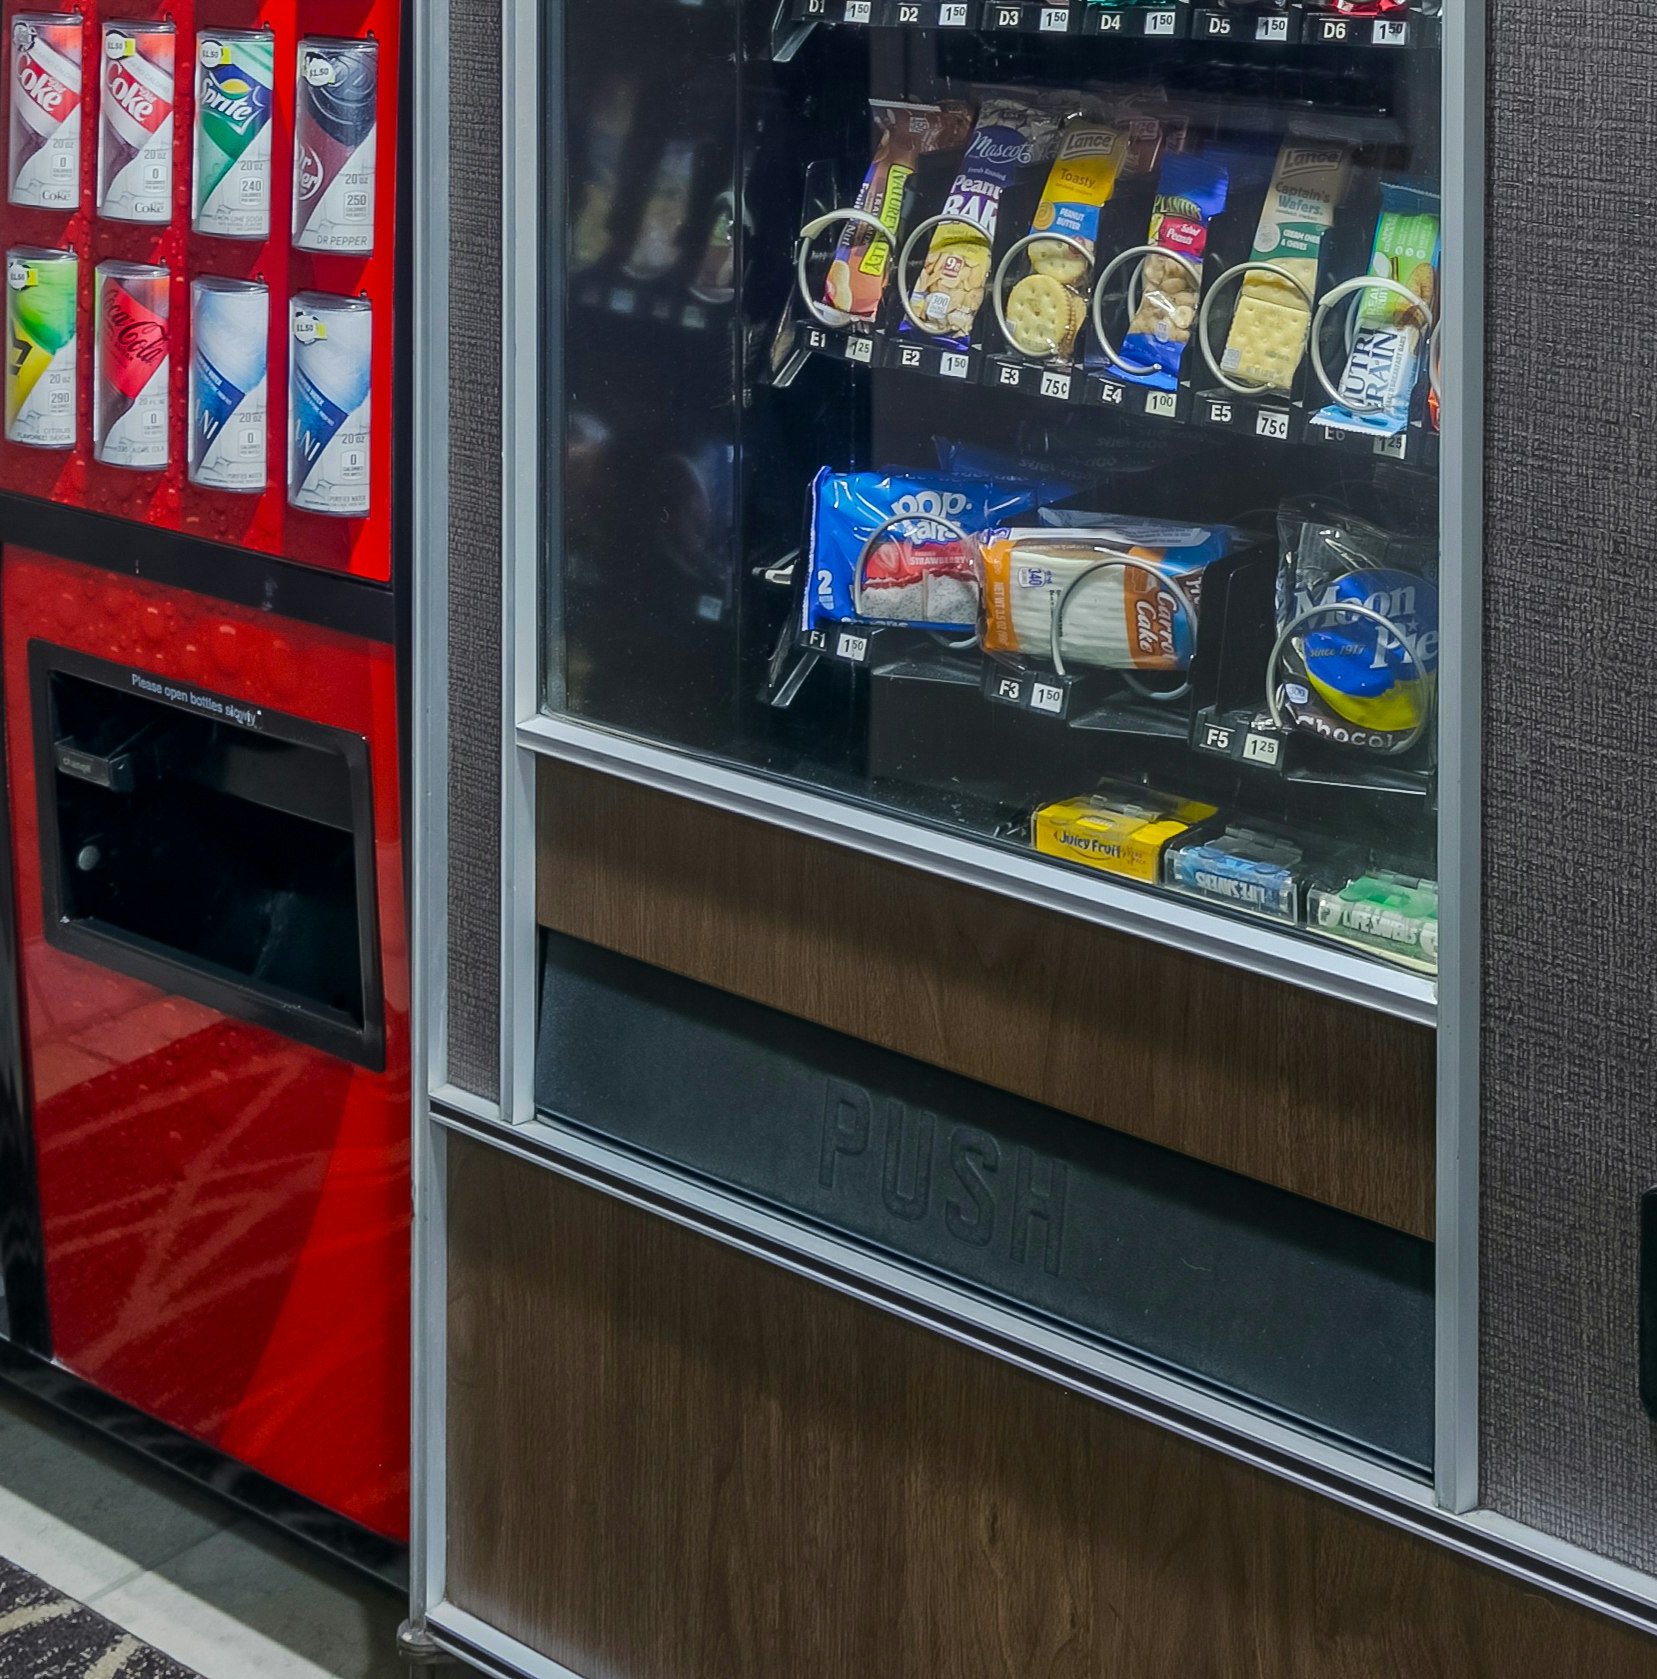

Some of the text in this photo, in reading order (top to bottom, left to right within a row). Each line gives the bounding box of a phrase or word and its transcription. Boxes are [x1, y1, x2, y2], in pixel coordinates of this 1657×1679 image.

[900, 7, 919, 22] D2
[999, 10, 1019, 26] D3
[1101, 14, 1120, 30] D4
[1209, 18, 1231, 34] D5
[1323, 22, 1346, 39] D6
[309, 68, 329, 77] $1.50
[16, 53, 62, 112] Coke
[107, 60, 153, 121] Coke
[203, 76, 253, 121] Sprite
[1066, 133, 1113, 152] Lance
[1283, 149, 1341, 168] Lance
[242, 181, 262, 192] 240
[1059, 168, 1095, 188] Toasty
[42, 190, 71, 201] Coke
[347, 194, 367, 206] 250
[1274, 180, 1331, 204] Captain's
[135, 202, 165, 213] Coke
[317, 234, 367, 246] DR PEPPER
[810, 331, 826, 347] E1
[902, 351, 921, 366] E2
[1000, 368, 1019, 384] E3
[51, 393, 70, 403] 290
[1102, 385, 1122, 403] E4
[1210, 405, 1232, 422] E5
[909, 556, 965, 566] STRAWBERRY
[818, 570, 833, 595] 2
[1294, 584, 1417, 629] Moon
[1136, 601, 1159, 653] Cake
[810, 632, 825, 647] F1
[1370, 617, 1439, 669] Pie
[1310, 647, 1335, 657] since
[132, 673, 223, 714] Please open bottles
[999, 680, 1019, 699] F3
[1207, 728, 1229, 748] F5
[1059, 830, 1122, 859] Juicy Fruit
[819, 1077, 1068, 1278] PUSH
